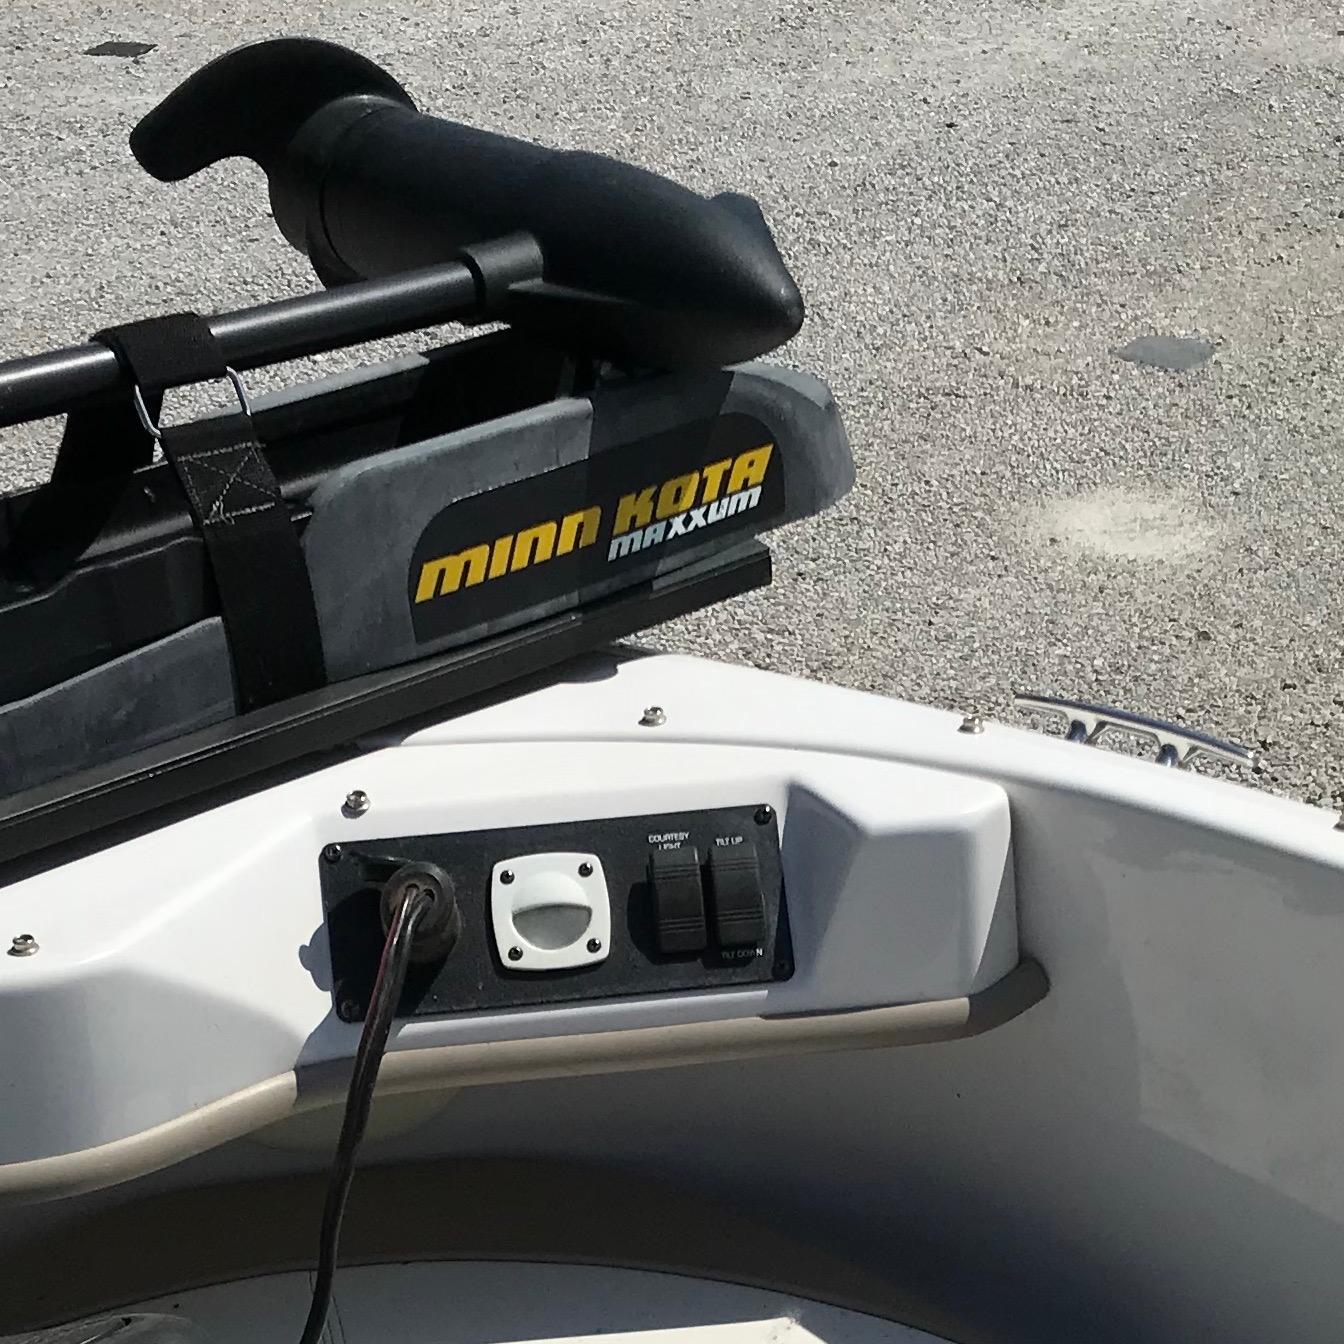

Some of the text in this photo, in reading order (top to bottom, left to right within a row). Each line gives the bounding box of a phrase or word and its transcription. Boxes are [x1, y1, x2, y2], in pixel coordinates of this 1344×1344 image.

[414, 443, 775, 604] MINN KOTA
[607, 485, 763, 562] MAXXUM
[648, 831, 690, 845] COURTESY
